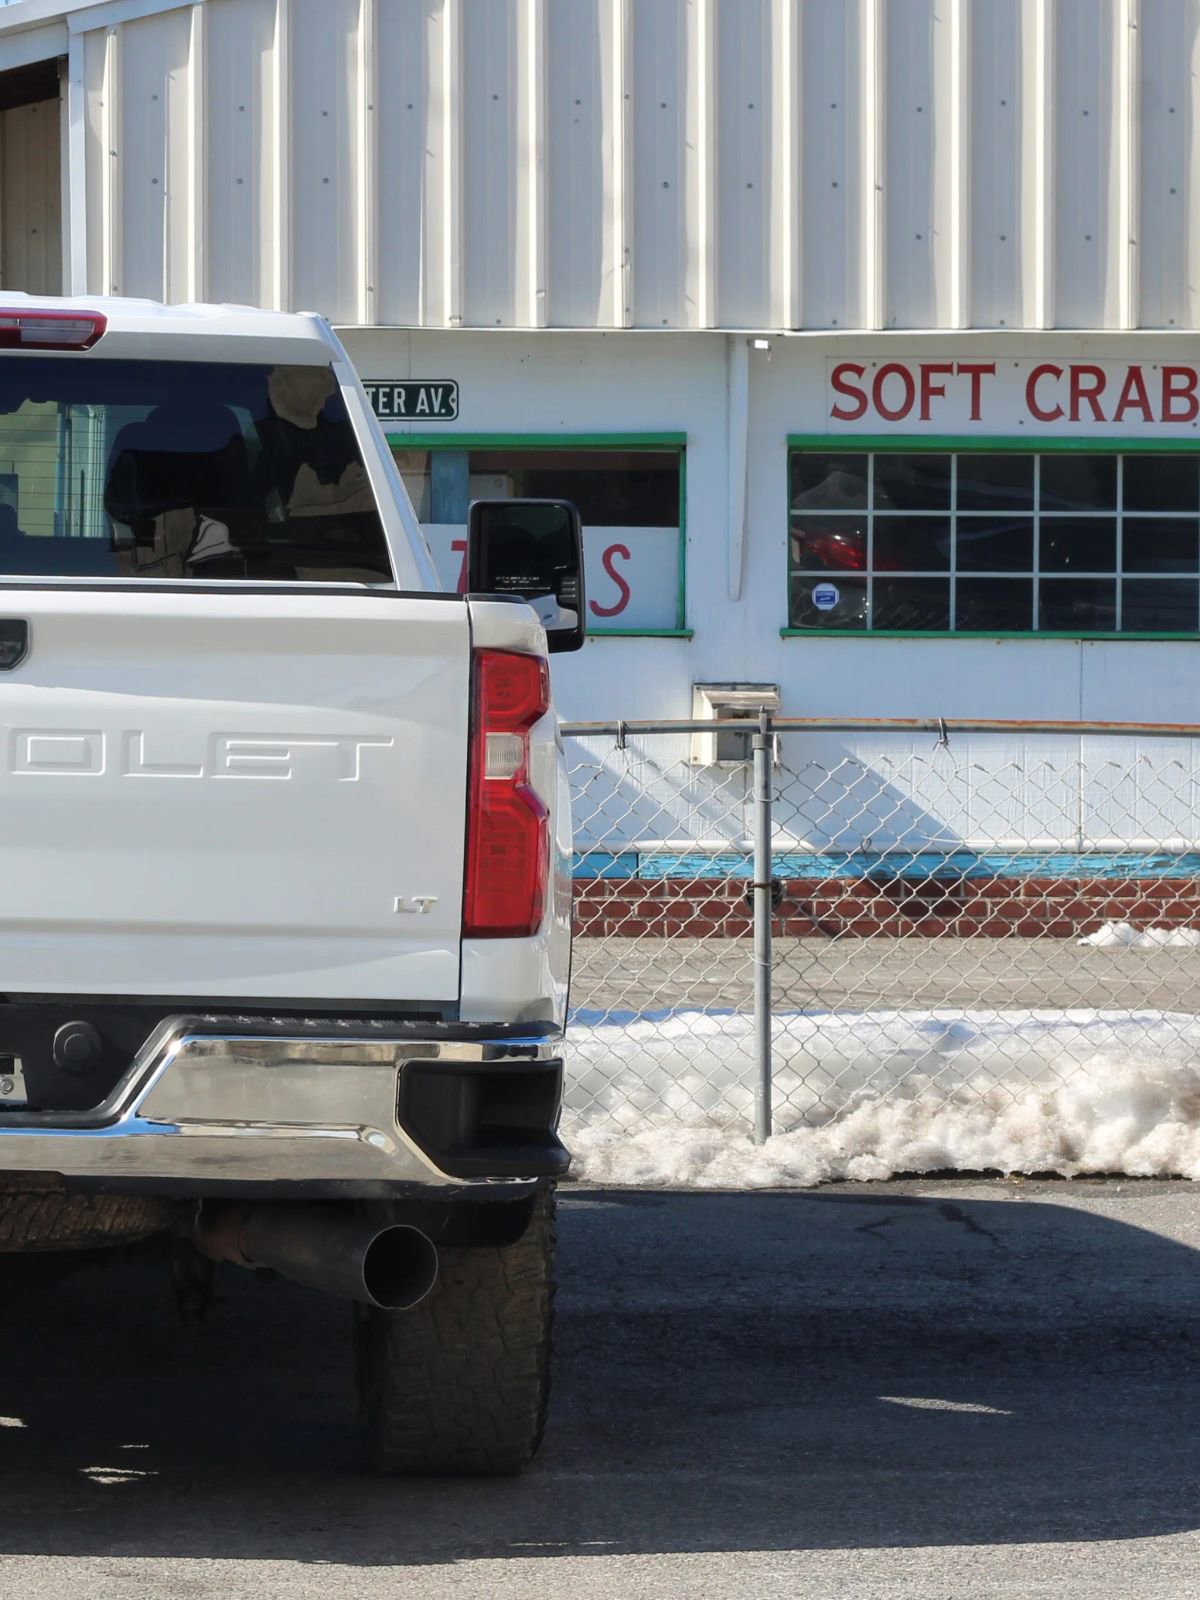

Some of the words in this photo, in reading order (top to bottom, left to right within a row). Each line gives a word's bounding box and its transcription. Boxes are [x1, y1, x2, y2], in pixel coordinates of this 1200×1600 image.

[415, 387, 446, 413] AV.
[829, 362, 997, 421] SOFT
[1025, 363, 1200, 423] CRAB
[393, 896, 438, 914] LT
